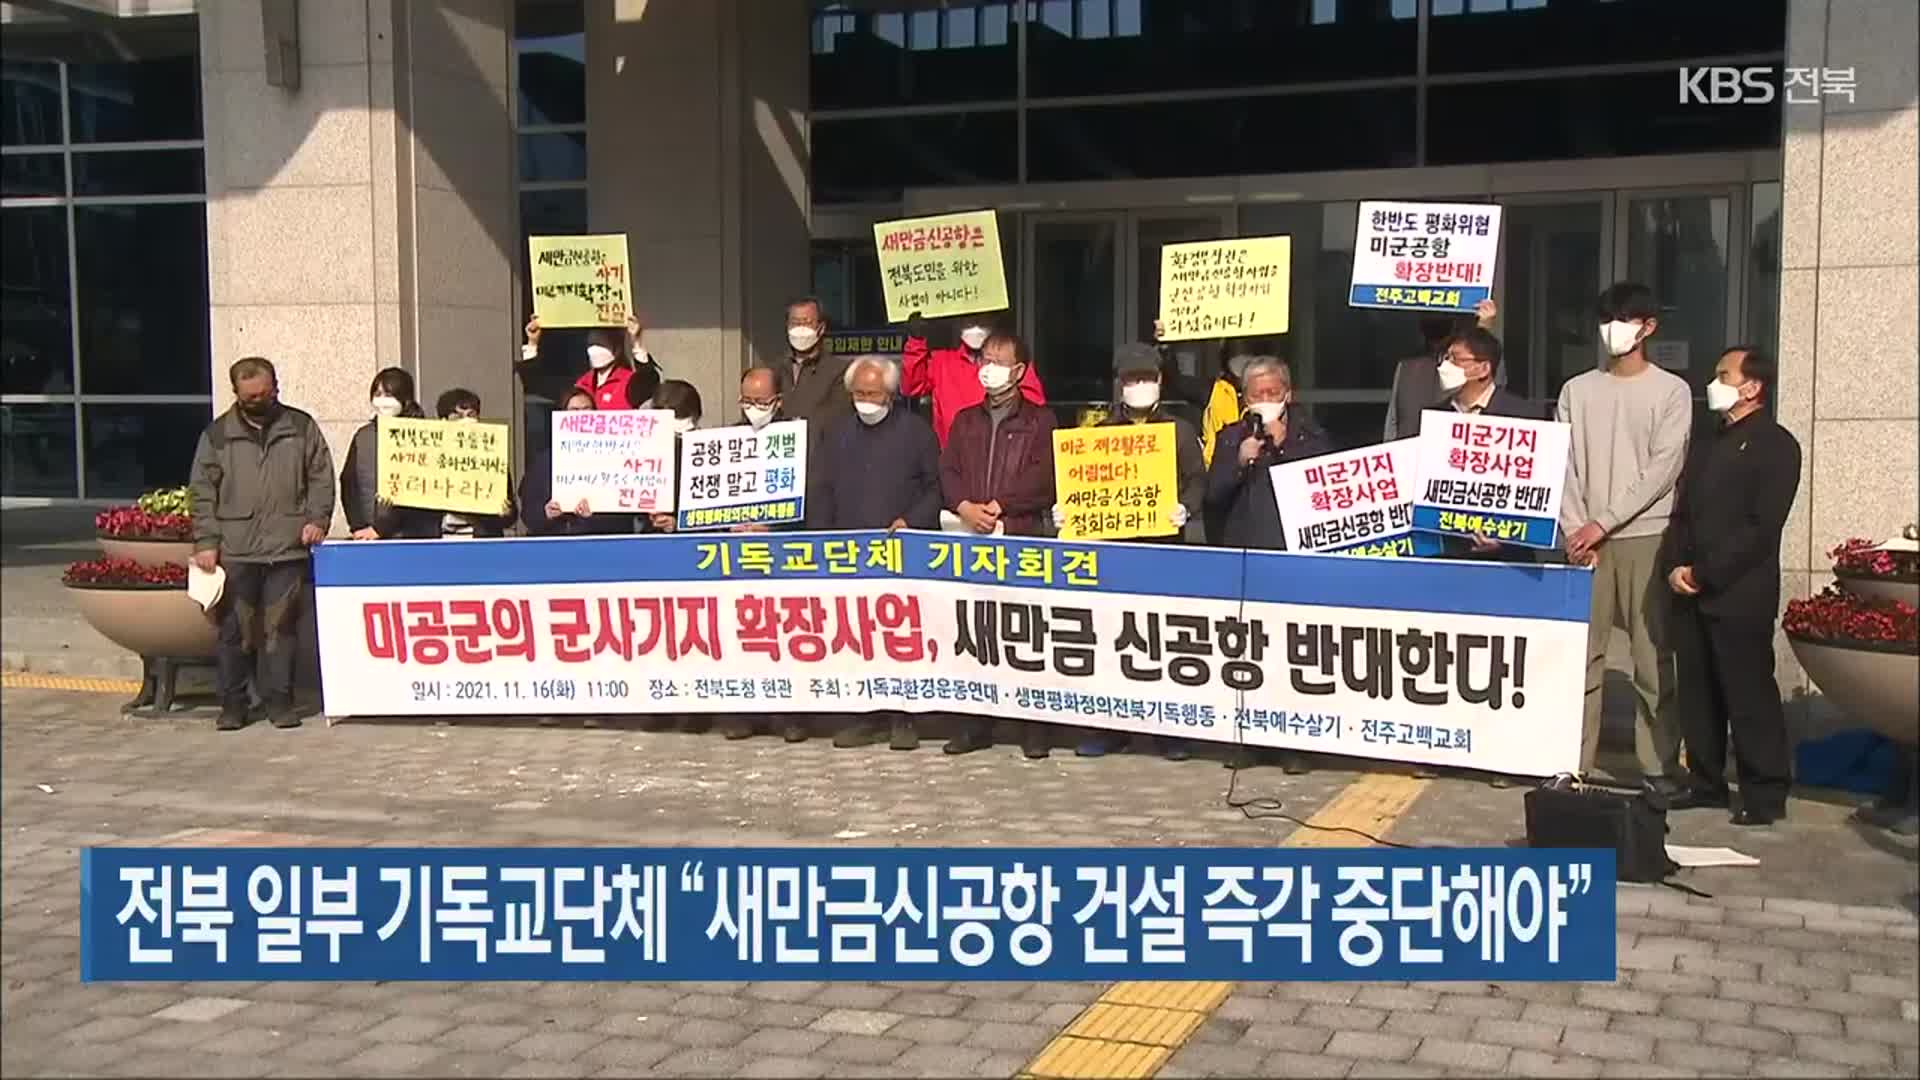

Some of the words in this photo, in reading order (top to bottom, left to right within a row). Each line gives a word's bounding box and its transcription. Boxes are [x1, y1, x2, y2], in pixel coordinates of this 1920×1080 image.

[1372, 210, 1418, 232] 한반도
[1425, 213, 1490, 236] 평화위협
[882, 224, 984, 251] 새만금신공항은
[1371, 236, 1451, 258] 미군공항
[596, 264, 624, 284] 사기
[888, 261, 946, 287] 전북도민을
[952, 259, 978, 277] 위한
[1395, 262, 1482, 283] 확장반대!
[899, 291, 929, 307] 사업이
[936, 285, 978, 304] 아니다!
[1375, 287, 1461, 306] 전주고백교회
[596, 303, 625, 324] 진실
[389, 428, 443, 448] 전북도민
[560, 414, 659, 438] 새만금신공항
[1452, 422, 1537, 453] 미군기지
[691, 439, 722, 467] 공항
[728, 438, 759, 463] 말고
[765, 432, 796, 461] 갯벌
[1060, 438, 1086, 456] 미군
[1093, 434, 1161, 456] 제2활주로
[623, 458, 662, 474] 사기
[1069, 462, 1138, 482] 어림없다!
[1304, 452, 1394, 487] 미군기지
[1448, 447, 1533, 480] 확장사업
[690, 474, 720, 499] 전쟁
[727, 471, 757, 497] 말고
[764, 467, 796, 494] 평화
[1065, 484, 1161, 508] 새만금신공항
[1311, 477, 1399, 511] 확장사업
[1423, 479, 1511, 511] 새만금신공항
[1514, 485, 1551, 512] 반대!
[618, 488, 658, 510] 진실
[1071, 511, 1156, 536] 철회하라!!
[1298, 509, 1385, 549] 새만금신공항
[1439, 511, 1527, 541] 전북예수살기
[696, 538, 904, 576] 기독교단체
[928, 541, 1100, 586] 기자회견
[363, 599, 536, 664] 미공군의
[551, 597, 722, 663] 군사기지
[734, 593, 938, 663] 확장사업,
[954, 599, 1098, 677] 새만금
[1114, 610, 1269, 693] 신공항
[1286, 621, 1527, 710] 반대한다!
[412, 681, 440, 700] 일시
[455, 681, 498, 699] 2021.
[533, 679, 575, 700] 16(화)
[587, 681, 629, 698] 11:00
[650, 679, 679, 700] 장소
[695, 678, 755, 699] 전북도청
[762, 679, 792, 698] 현관
[810, 679, 840, 698] 주최
[857, 678, 998, 704] 기독교환경운동연대
[1015, 686, 1216, 728] 생명평화정의전북기독행동
[1235, 708, 1341, 738] 전북예수살기
[1361, 719, 1471, 753] 전주고백교회
